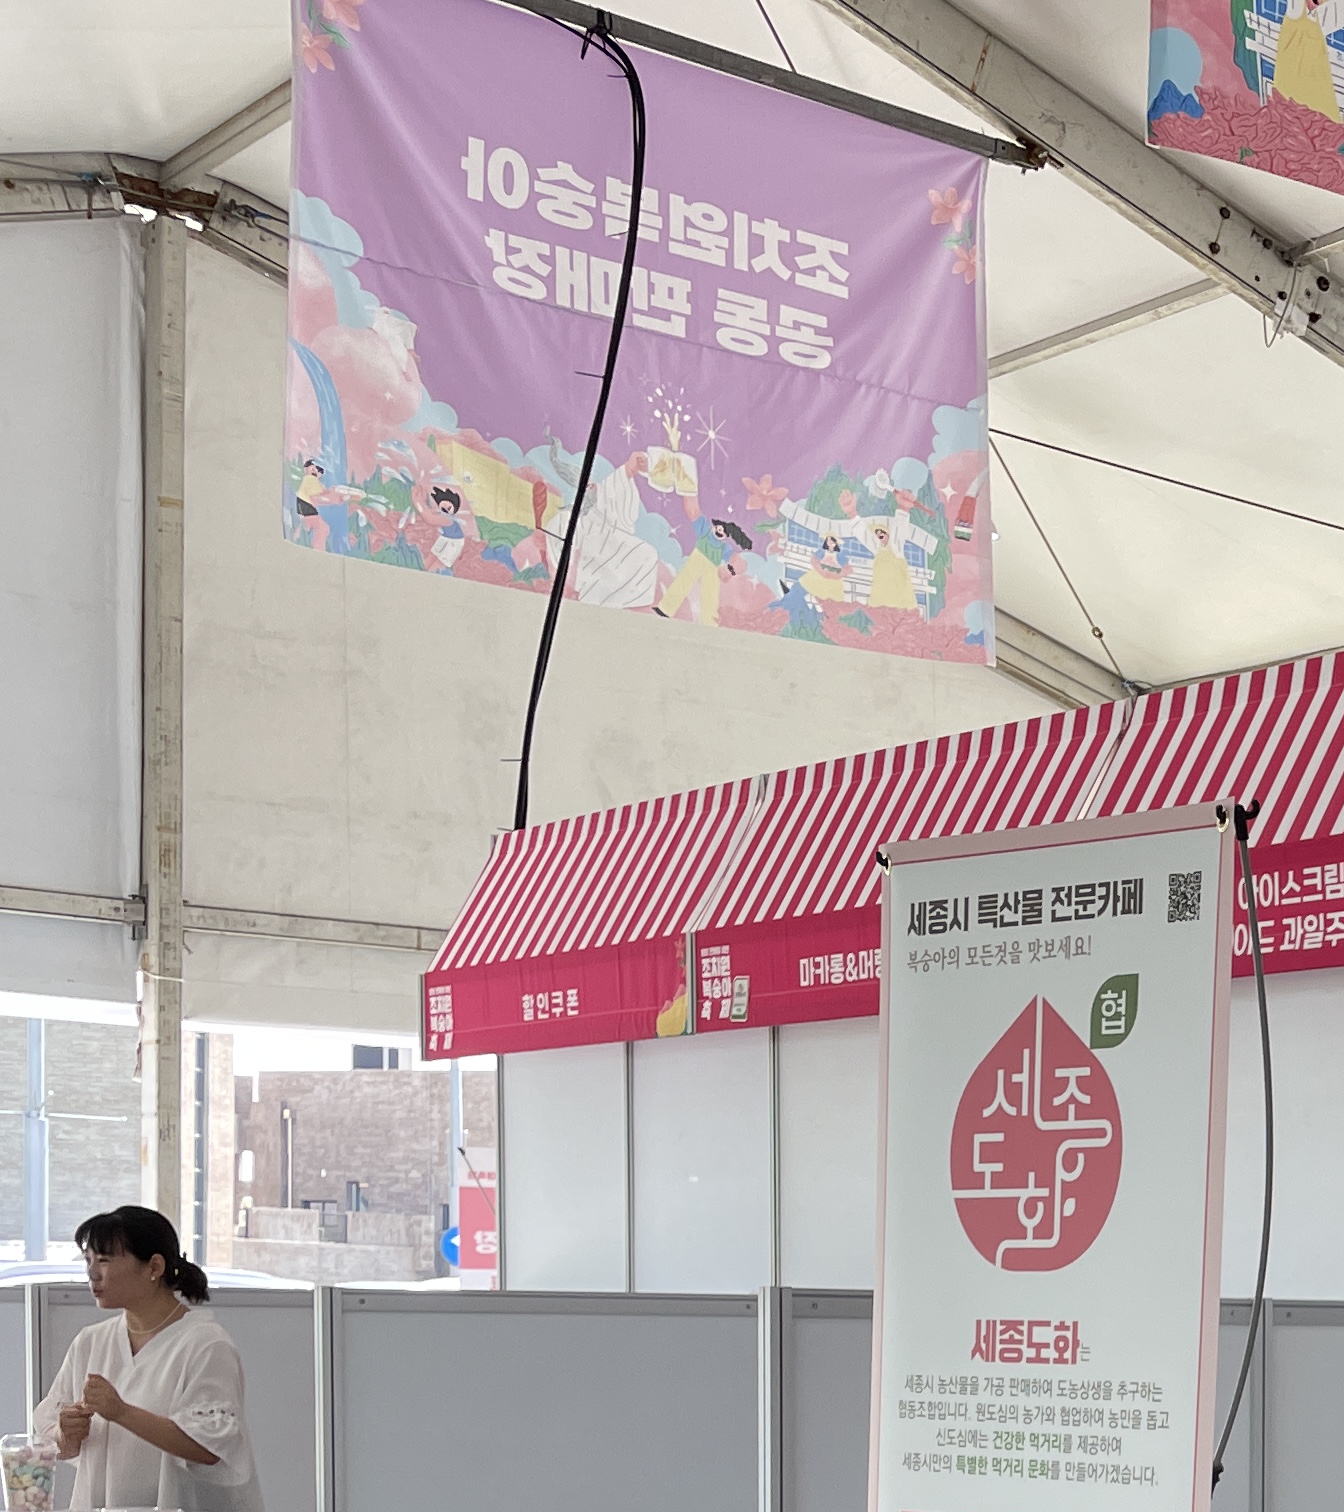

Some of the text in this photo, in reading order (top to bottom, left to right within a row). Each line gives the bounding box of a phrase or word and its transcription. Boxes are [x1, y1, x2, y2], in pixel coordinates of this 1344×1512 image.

[907, 878, 1144, 936] 세종시 특산물 전문카페
[702, 955, 730, 978] 조치원
[907, 935, 1092, 973] 복숭아의 모든것을 맛보세요!
[702, 976, 731, 999] 복숭아
[522, 988, 579, 1021] 할인쿠폰
[1100, 989, 1127, 1036] 협
[971, 1319, 1091, 1365] 세종도화는
[905, 1375, 1163, 1402] 세종시 농산물을 가공 판매하여 도농상생을 추구하는
[976, 1402, 1019, 1423] 원도심의
[1022, 1405, 1055, 1425] 농가와
[1060, 1406, 1104, 1428] 협업하여
[1108, 1408, 1142, 1429] 농민을
[1146, 1410, 1169, 1430] 돕고
[936, 1428, 1122, 1456] 신도심에는 건강한 먹거리를 제공하여
[902, 1452, 952, 1473] 세종시만의
[956, 1455, 988, 1475] 특별한
[992, 1457, 1024, 1478] 먹거리
[1028, 1459, 1060, 1480] 문화를
